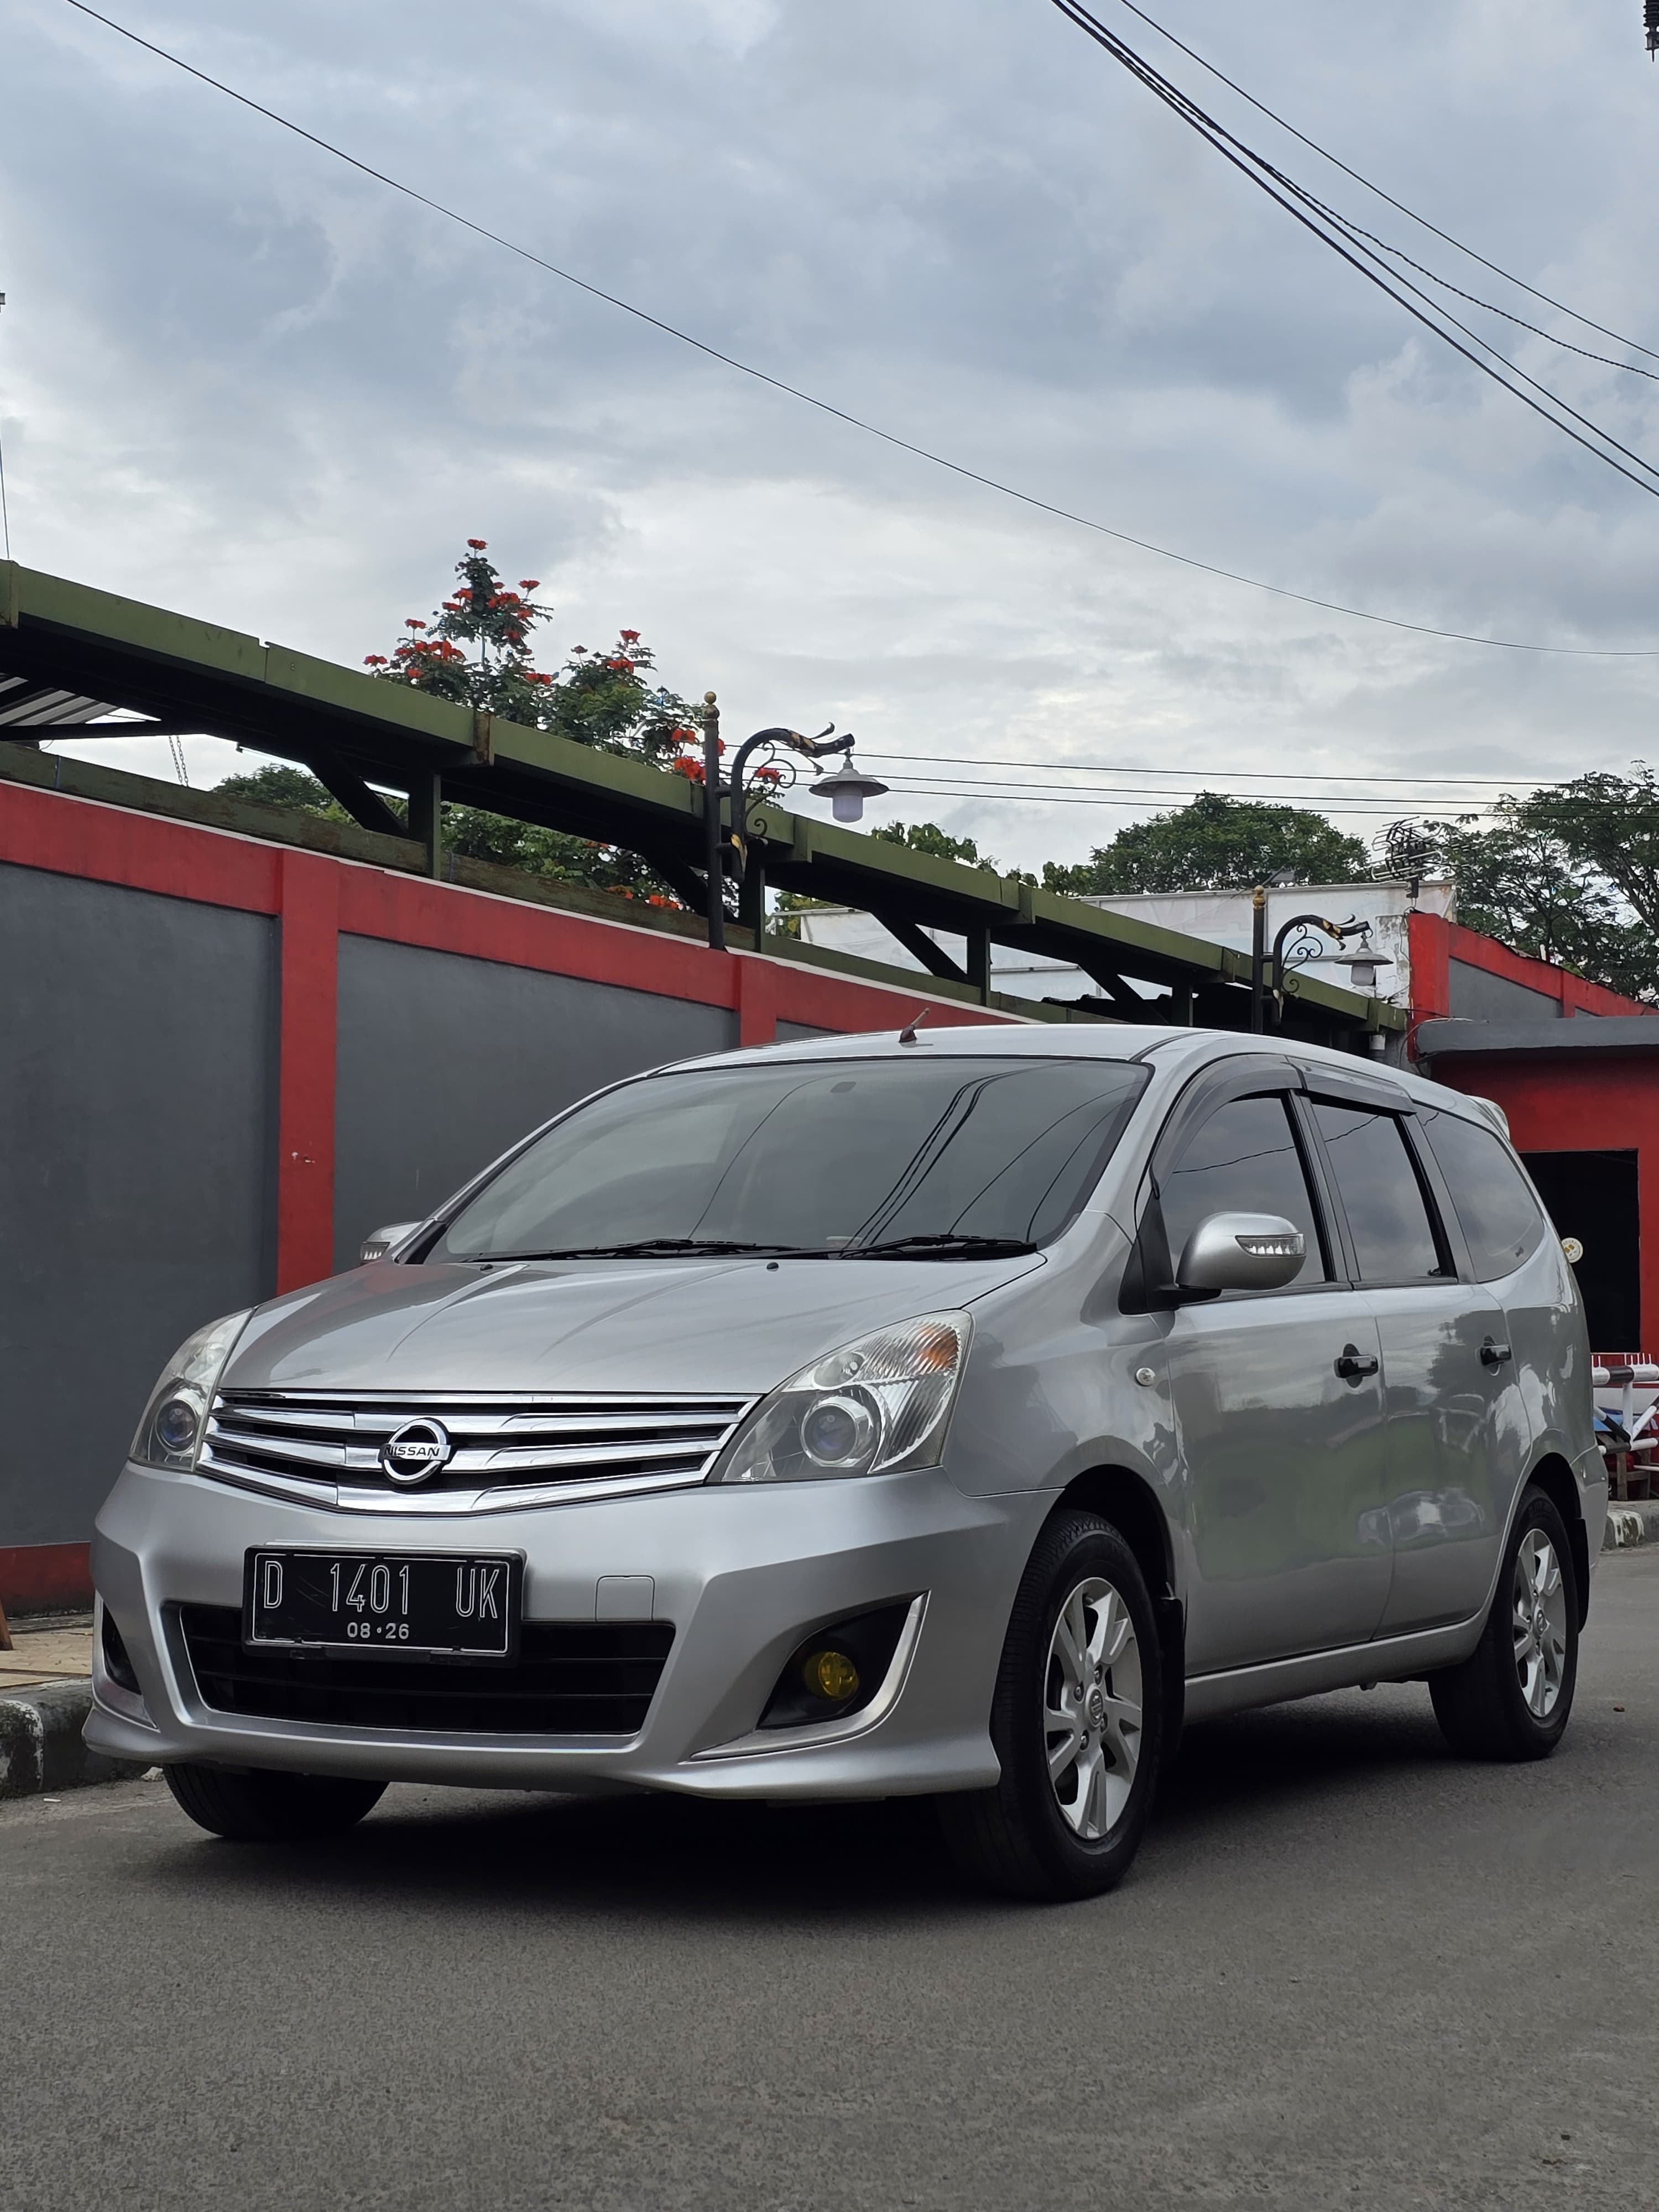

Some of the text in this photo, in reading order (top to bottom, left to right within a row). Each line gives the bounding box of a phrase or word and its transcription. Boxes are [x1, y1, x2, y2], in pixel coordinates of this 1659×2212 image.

[384, 1444, 440, 1457] NISSAN
[263, 1561, 500, 1619] D 1401 UK
